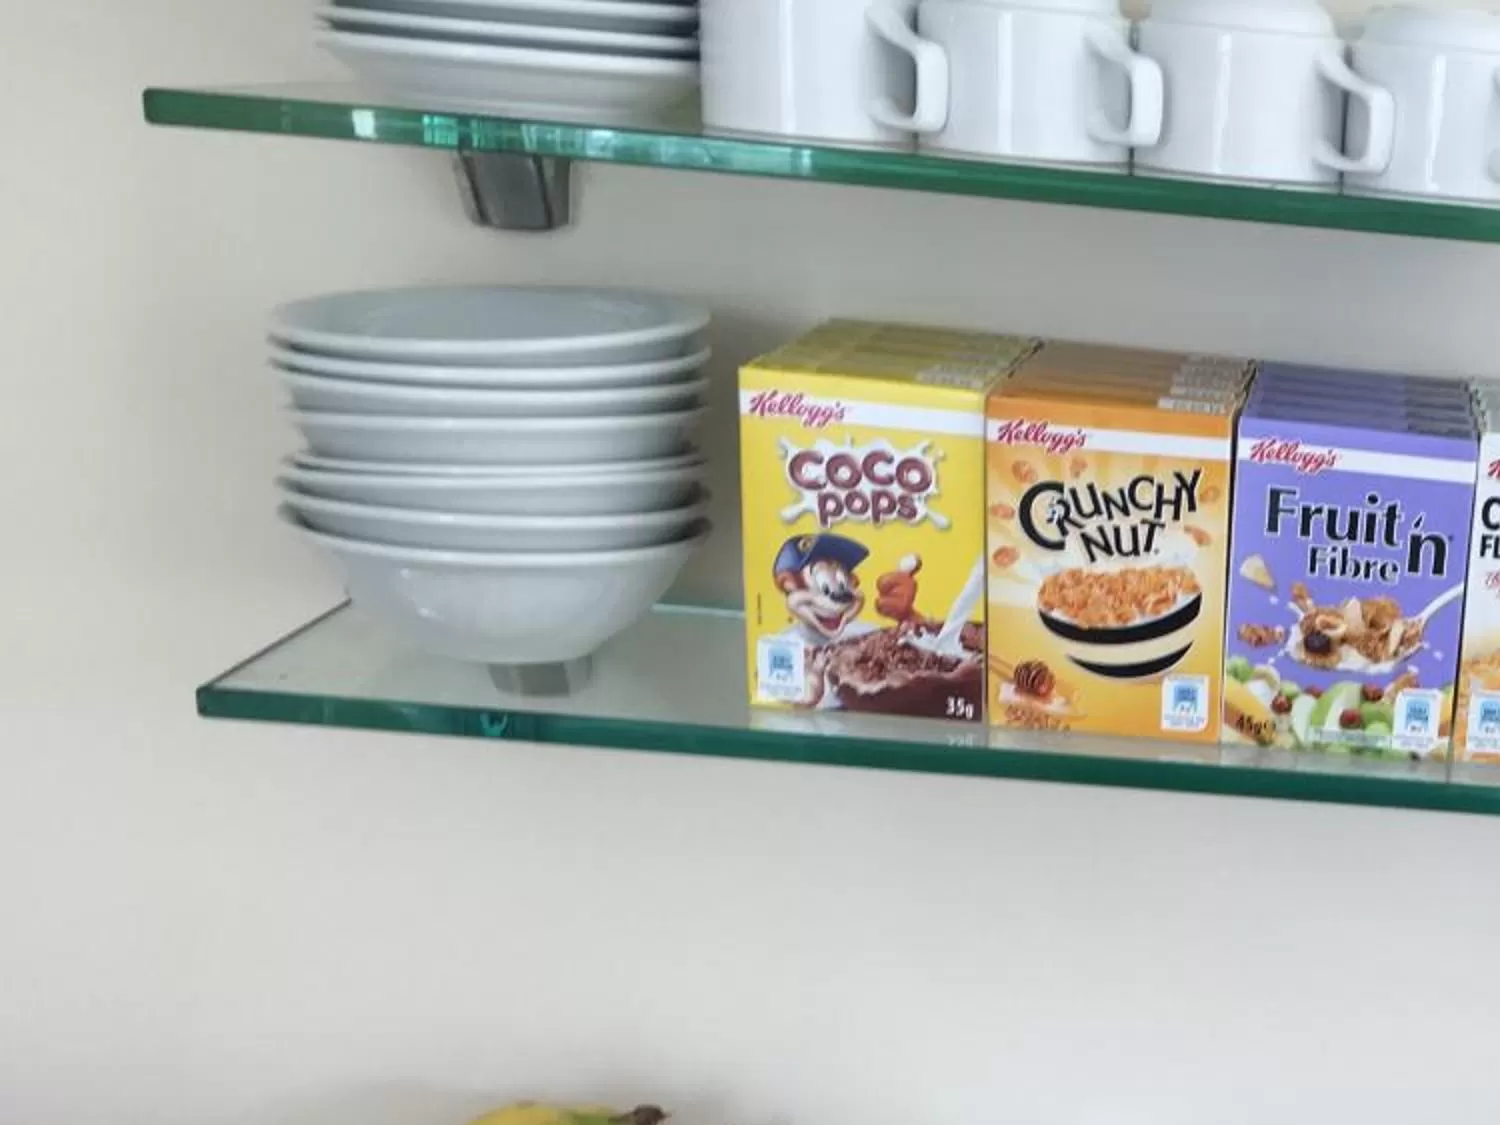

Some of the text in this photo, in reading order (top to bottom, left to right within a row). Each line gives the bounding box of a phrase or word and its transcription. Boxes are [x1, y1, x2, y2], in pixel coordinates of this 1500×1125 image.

[749, 389, 847, 429] Kellogg's
[997, 419, 1089, 453] Kellogg's
[1250, 438, 1339, 472] Kellogg's
[787, 449, 934, 495] COCO
[817, 488, 919, 527] pops
[1018, 468, 1204, 552] CRUNCHY
[1266, 486, 1403, 550] Fruit
[1079, 520, 1165, 564] NUT
[1308, 546, 1398, 584] Fibre
[945, 697, 974, 720] 35g
